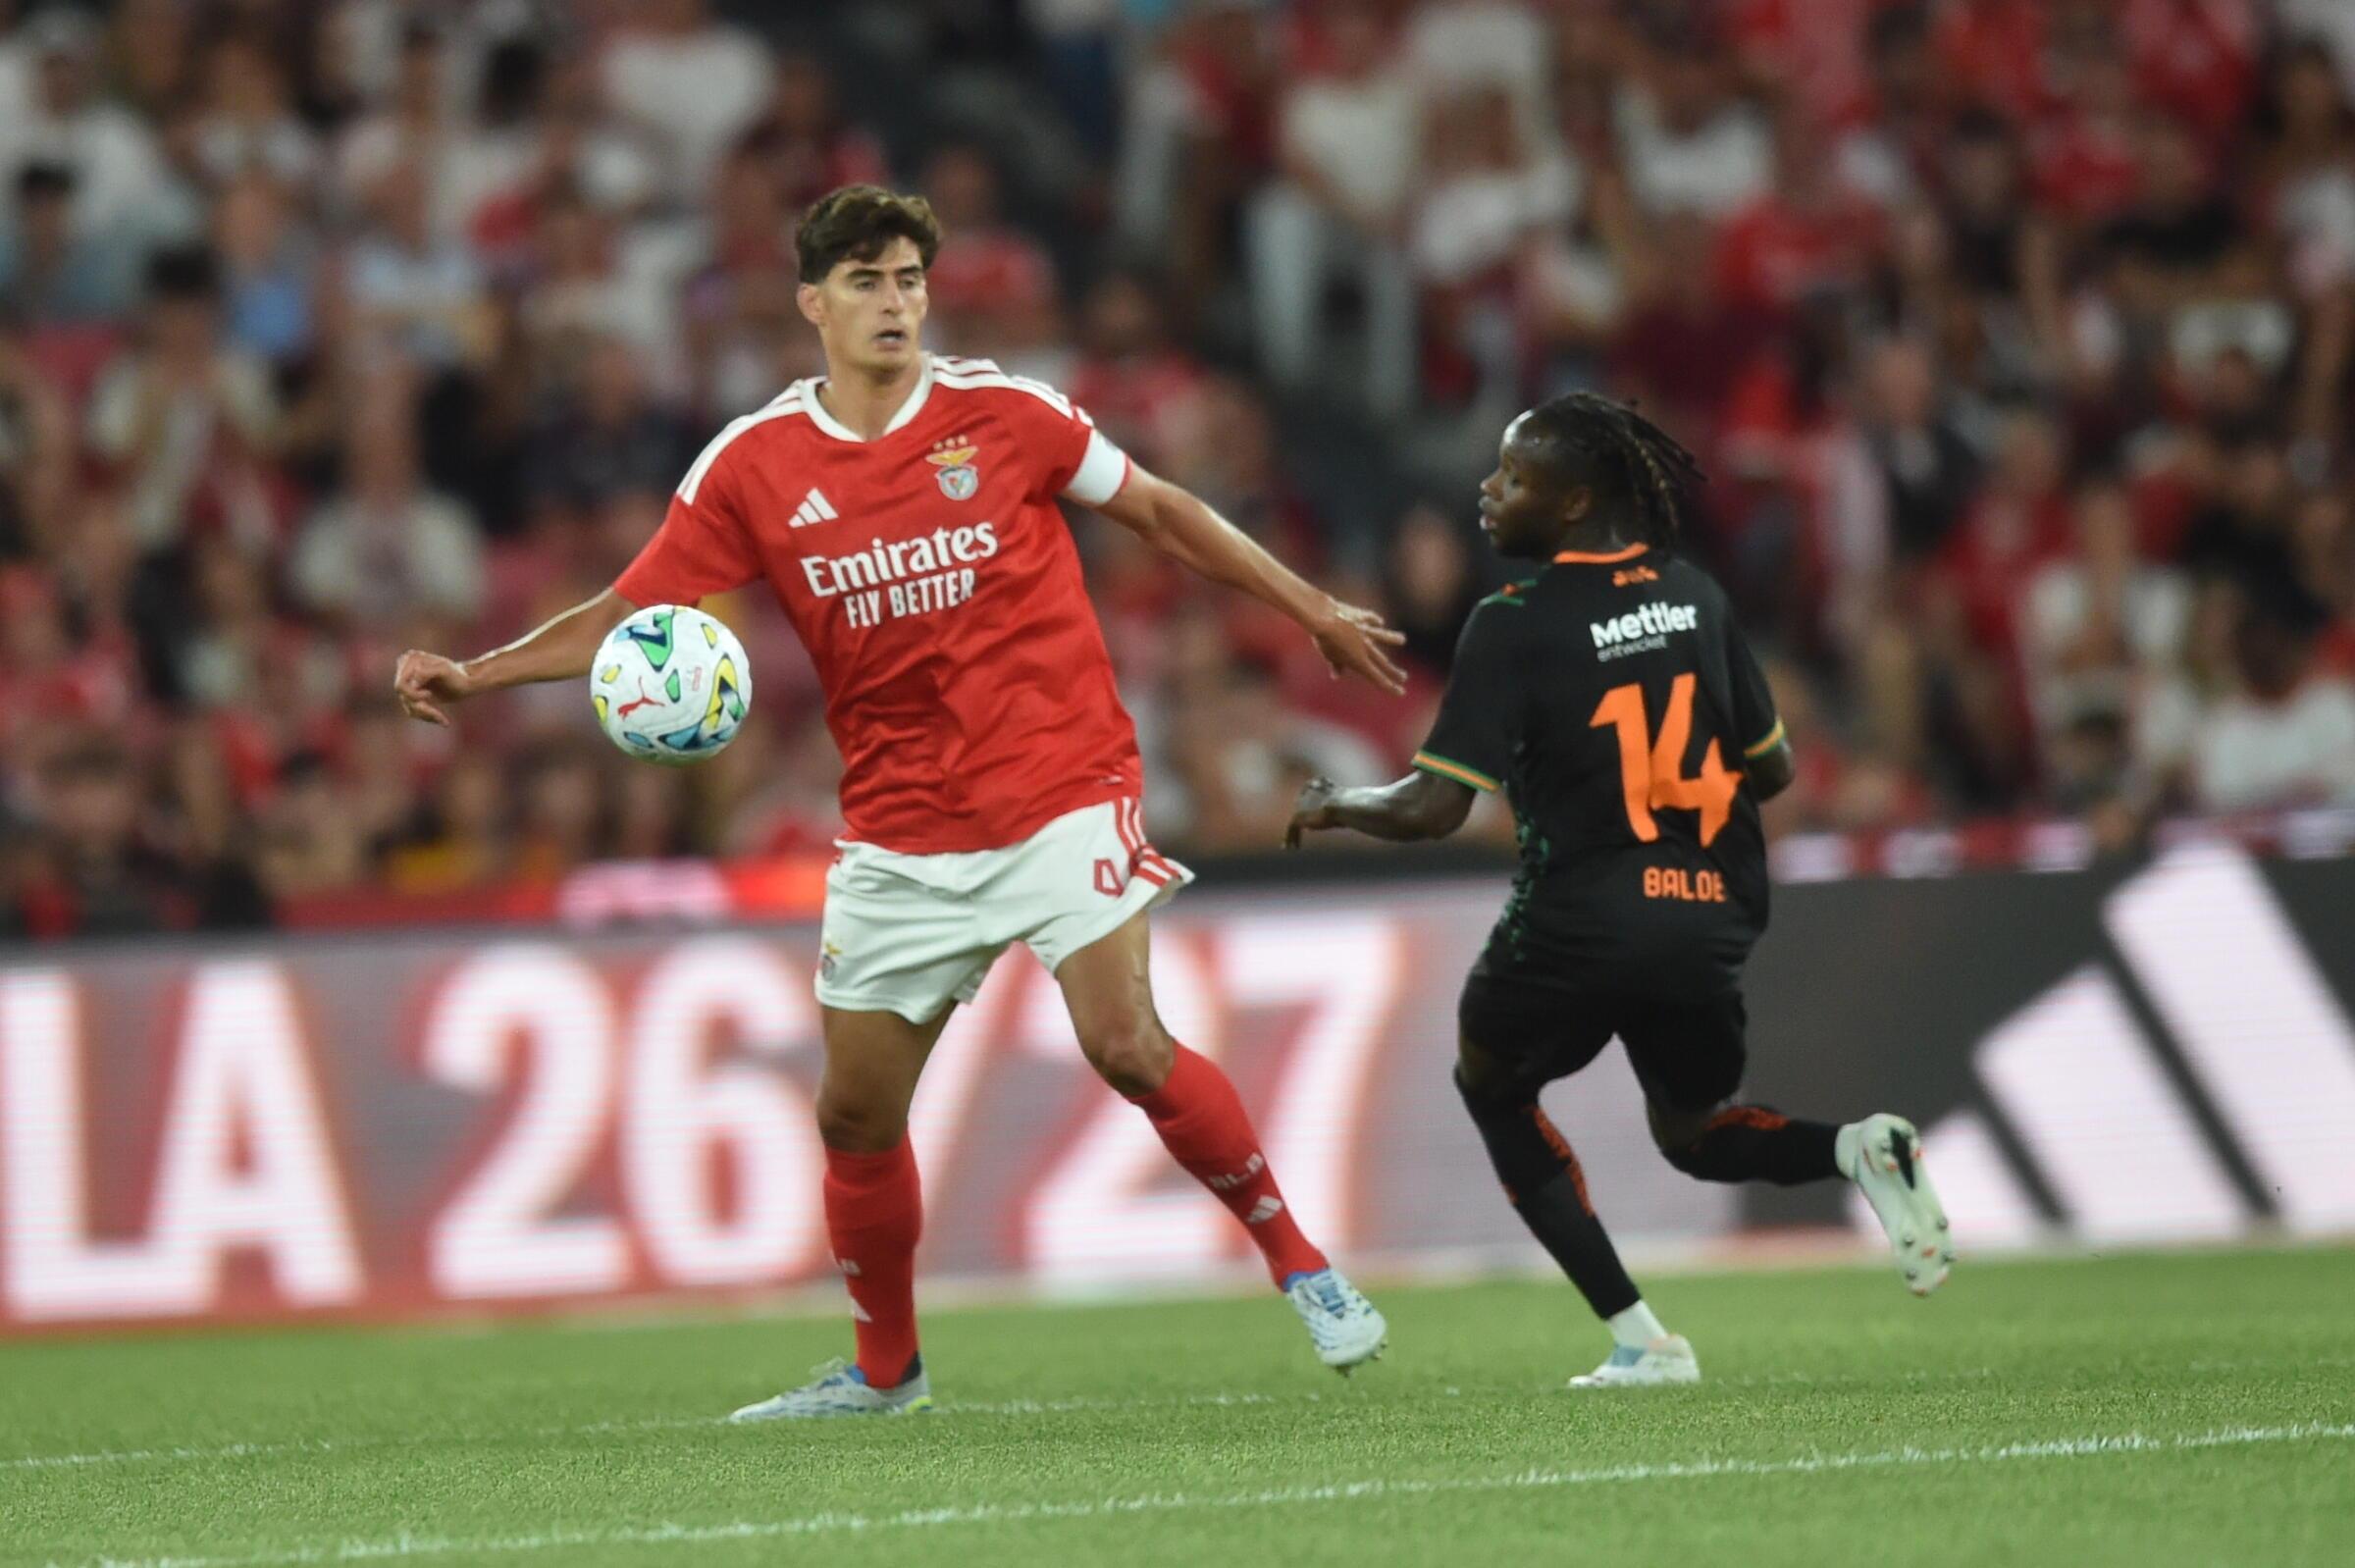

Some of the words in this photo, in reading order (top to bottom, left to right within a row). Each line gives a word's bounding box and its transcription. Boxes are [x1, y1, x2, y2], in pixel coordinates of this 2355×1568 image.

[800, 521, 999, 598] Emirates
[844, 587, 881, 629] FLY
[889, 568, 975, 618] BETTER
[1590, 601, 1697, 649] Mettler
[1589, 672, 1745, 847] 14
[2, 958, 363, 1321] LA
